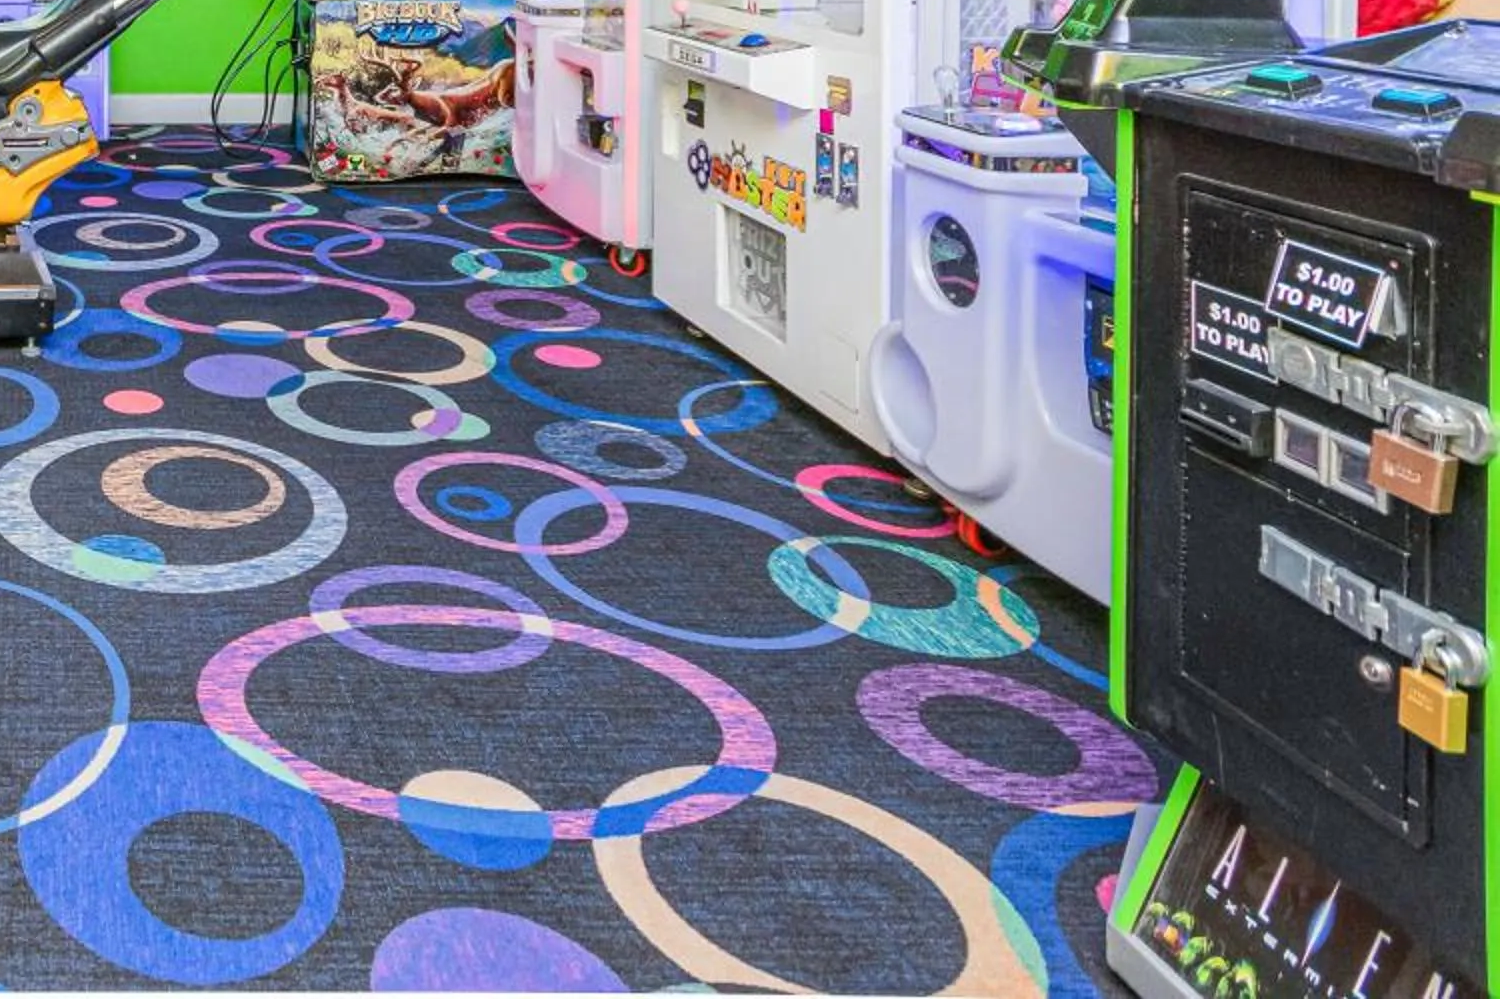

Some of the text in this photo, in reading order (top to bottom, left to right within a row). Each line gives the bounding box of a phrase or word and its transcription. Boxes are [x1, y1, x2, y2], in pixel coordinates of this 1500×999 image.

[357, 0, 396, 25] BIG
[710, 153, 807, 233] MASTER
[1297, 261, 1356, 295] $1.00
[1208, 302, 1261, 334] $1.00
[1276, 282, 1364, 329] TO PLAY
[1197, 322, 1222, 346] TO
